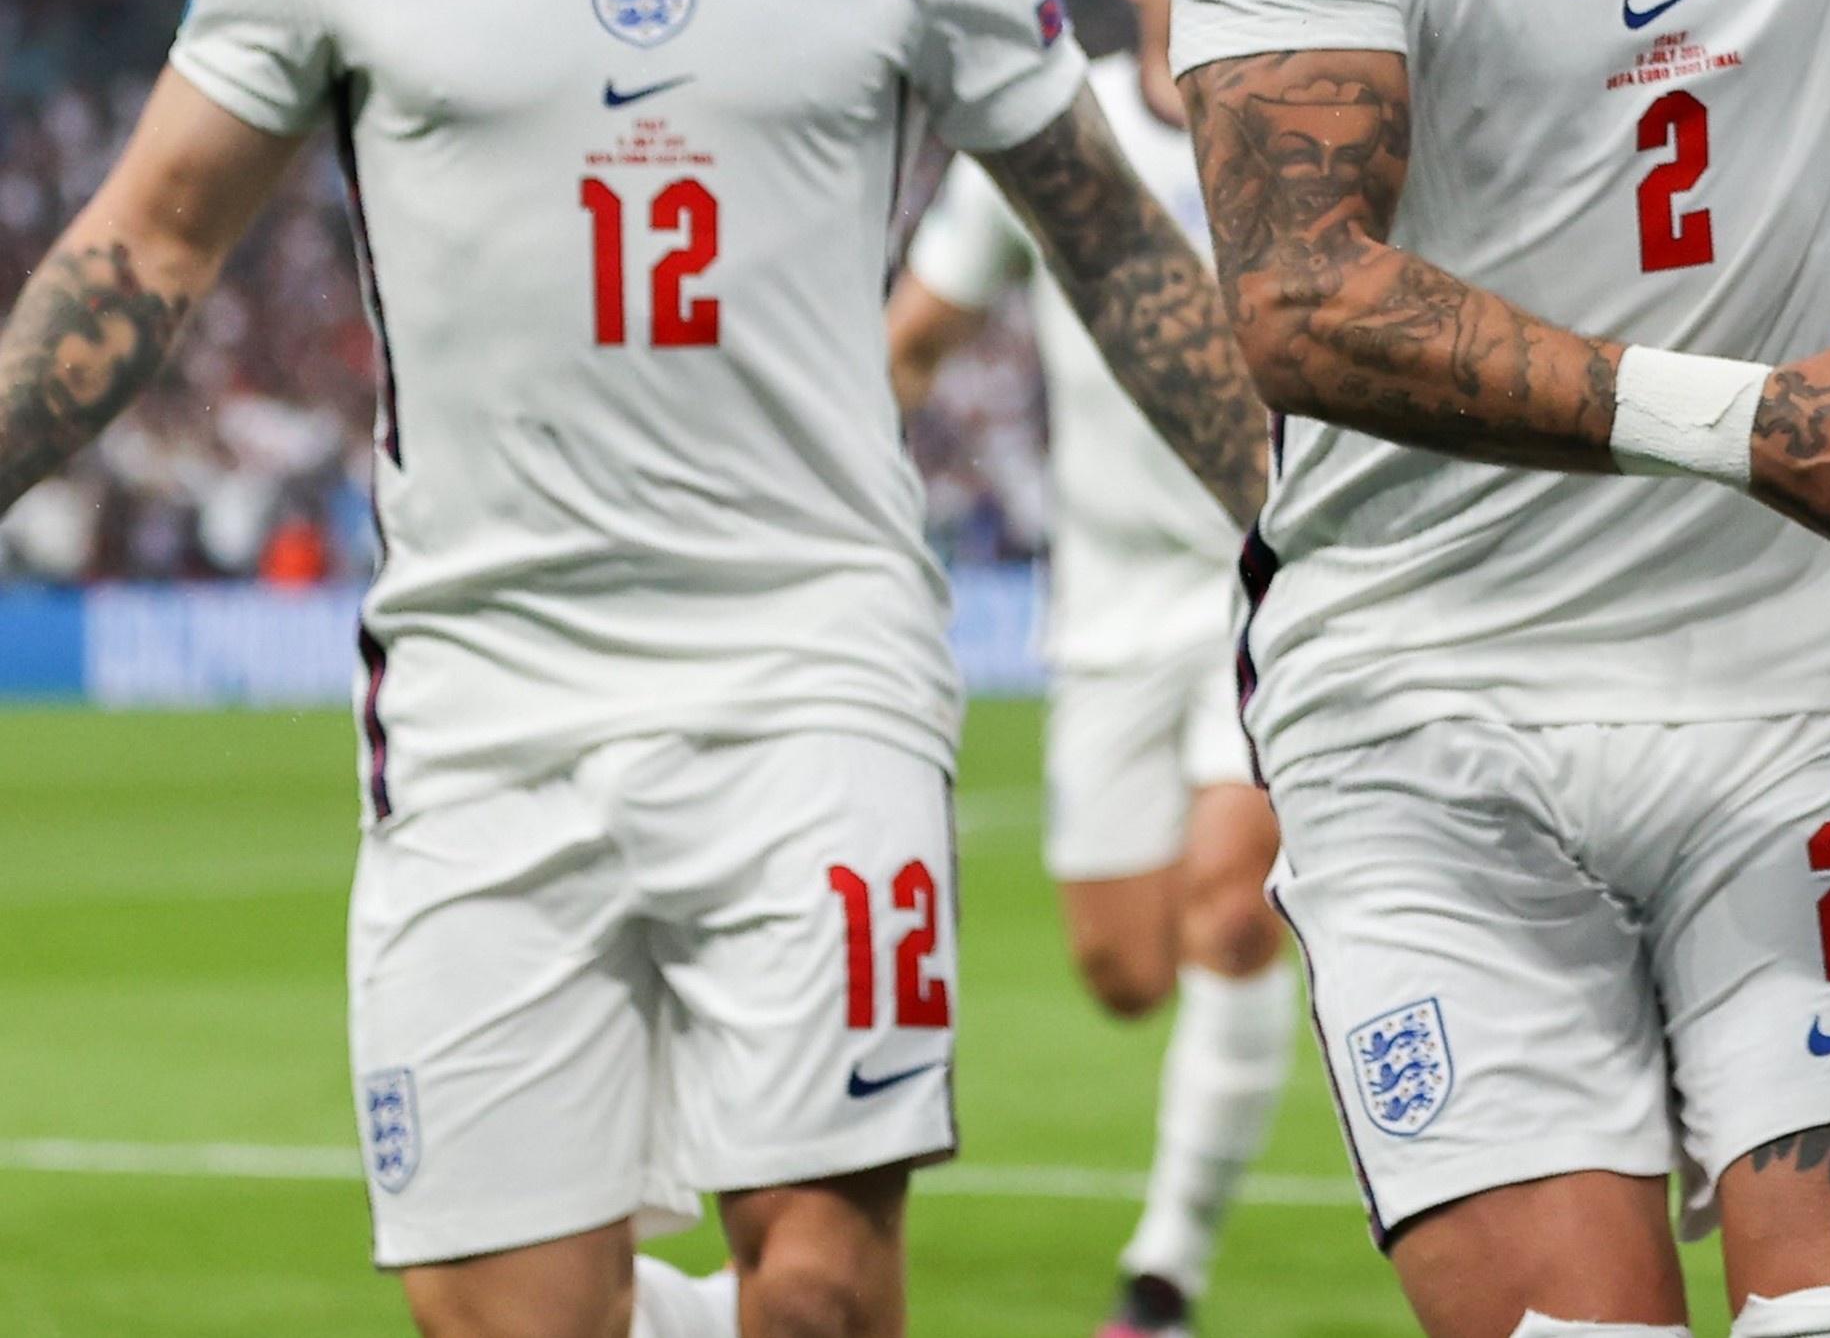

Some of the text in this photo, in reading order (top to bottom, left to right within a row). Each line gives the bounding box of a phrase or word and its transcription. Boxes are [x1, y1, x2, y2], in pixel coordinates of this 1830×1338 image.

[580, 176, 719, 348] 12
[1637, 90, 1714, 273] 2
[828, 858, 951, 1029] 12
